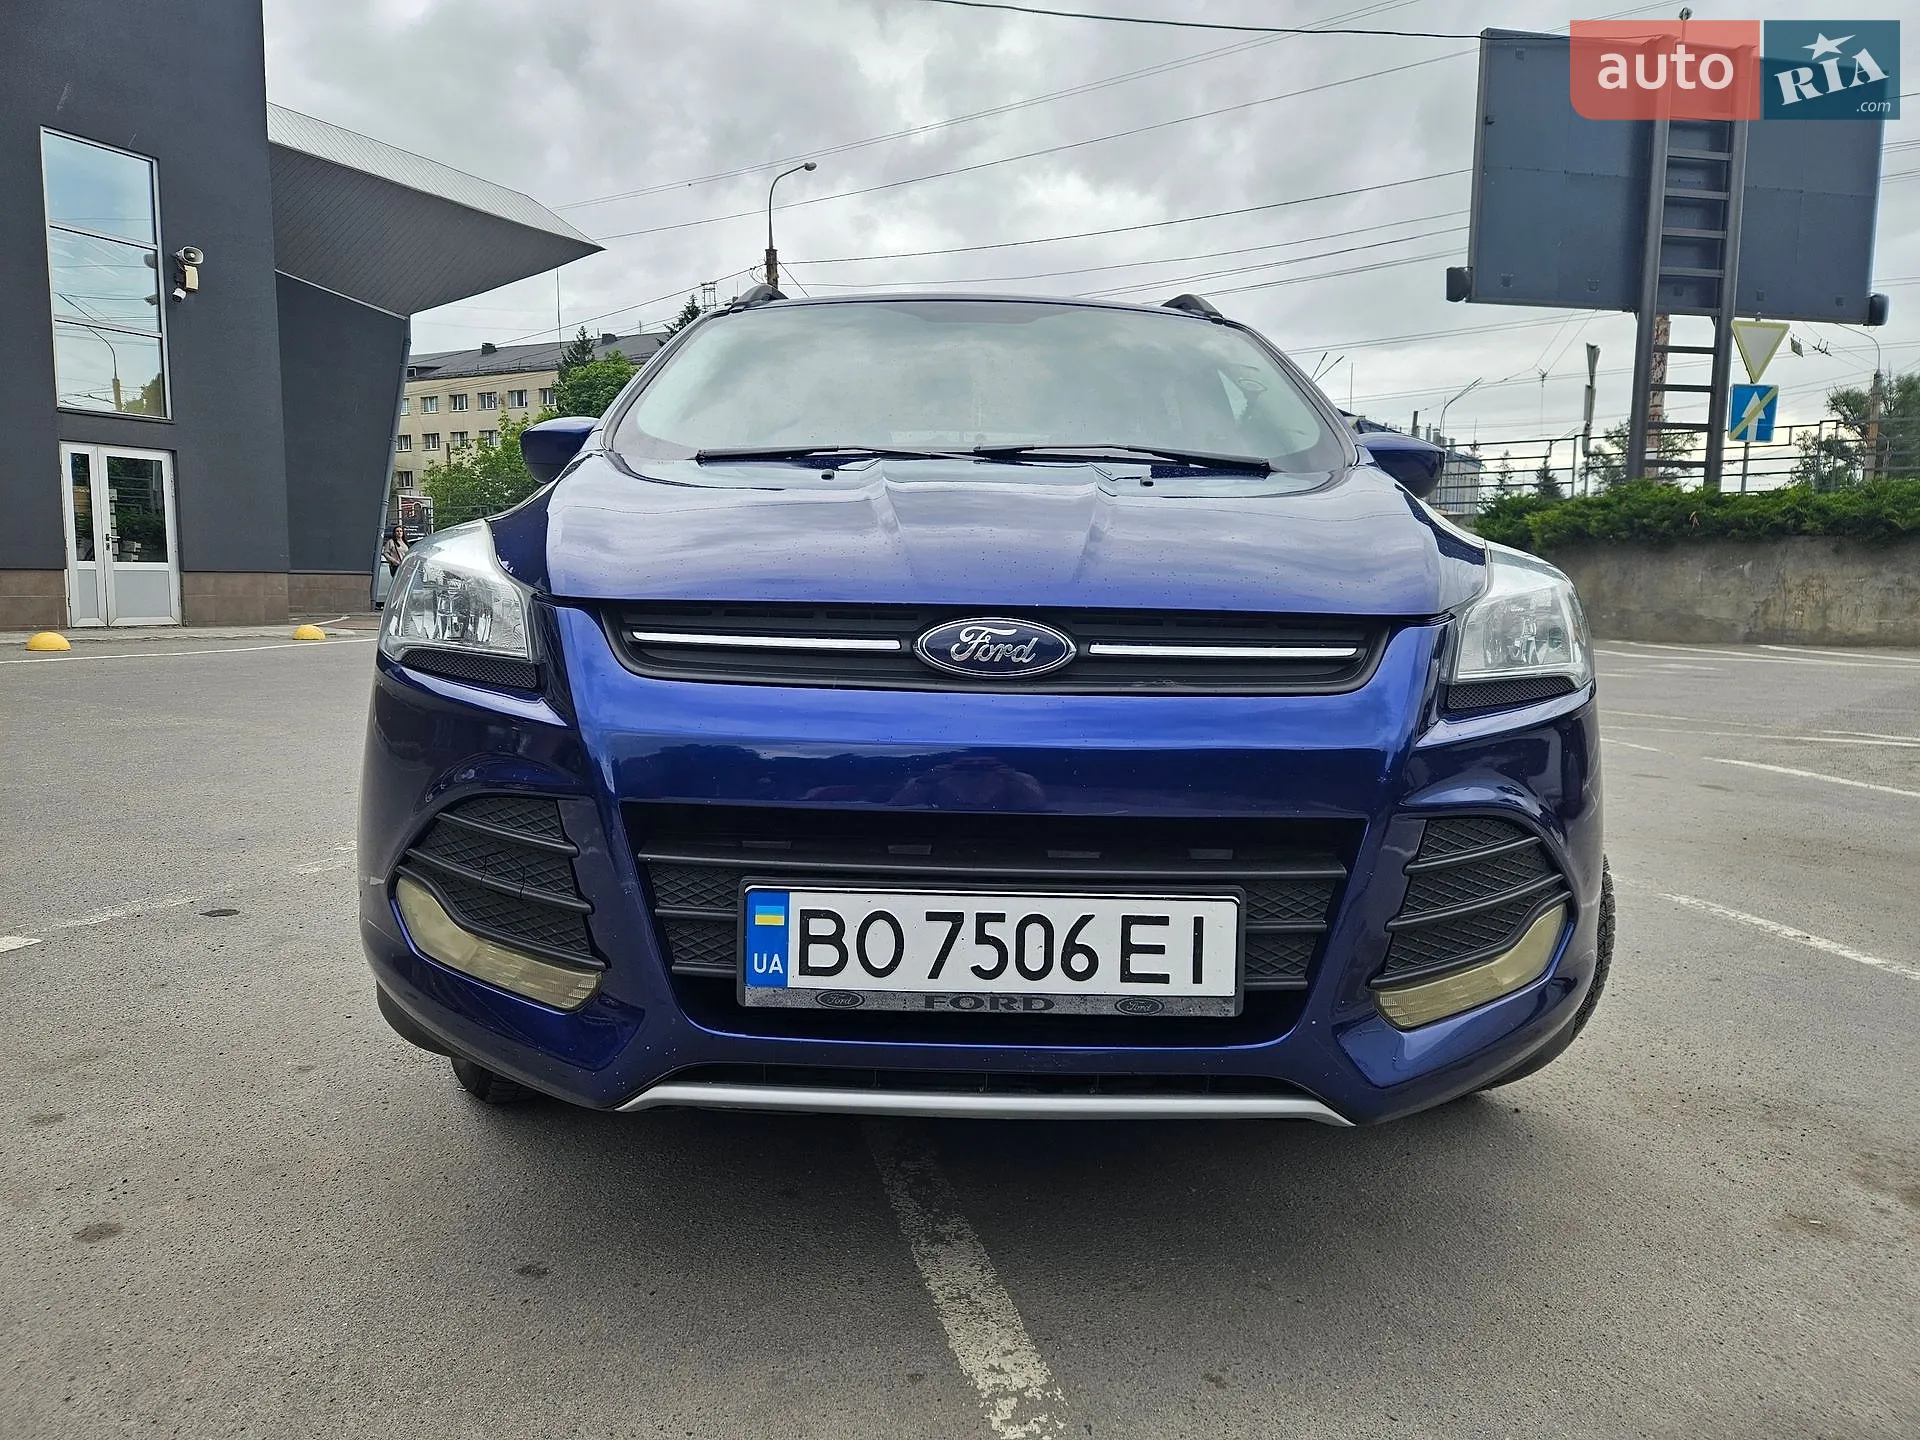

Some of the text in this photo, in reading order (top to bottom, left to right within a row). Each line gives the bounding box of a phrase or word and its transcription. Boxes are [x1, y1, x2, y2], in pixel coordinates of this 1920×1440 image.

[950, 625, 1039, 664] Ford
[798, 908, 1205, 985] BO 7506 EI
[753, 952, 784, 975] UA
[827, 993, 853, 1005] Ford
[923, 994, 1055, 1012] FORD
[1125, 1001, 1152, 1013] Ford
